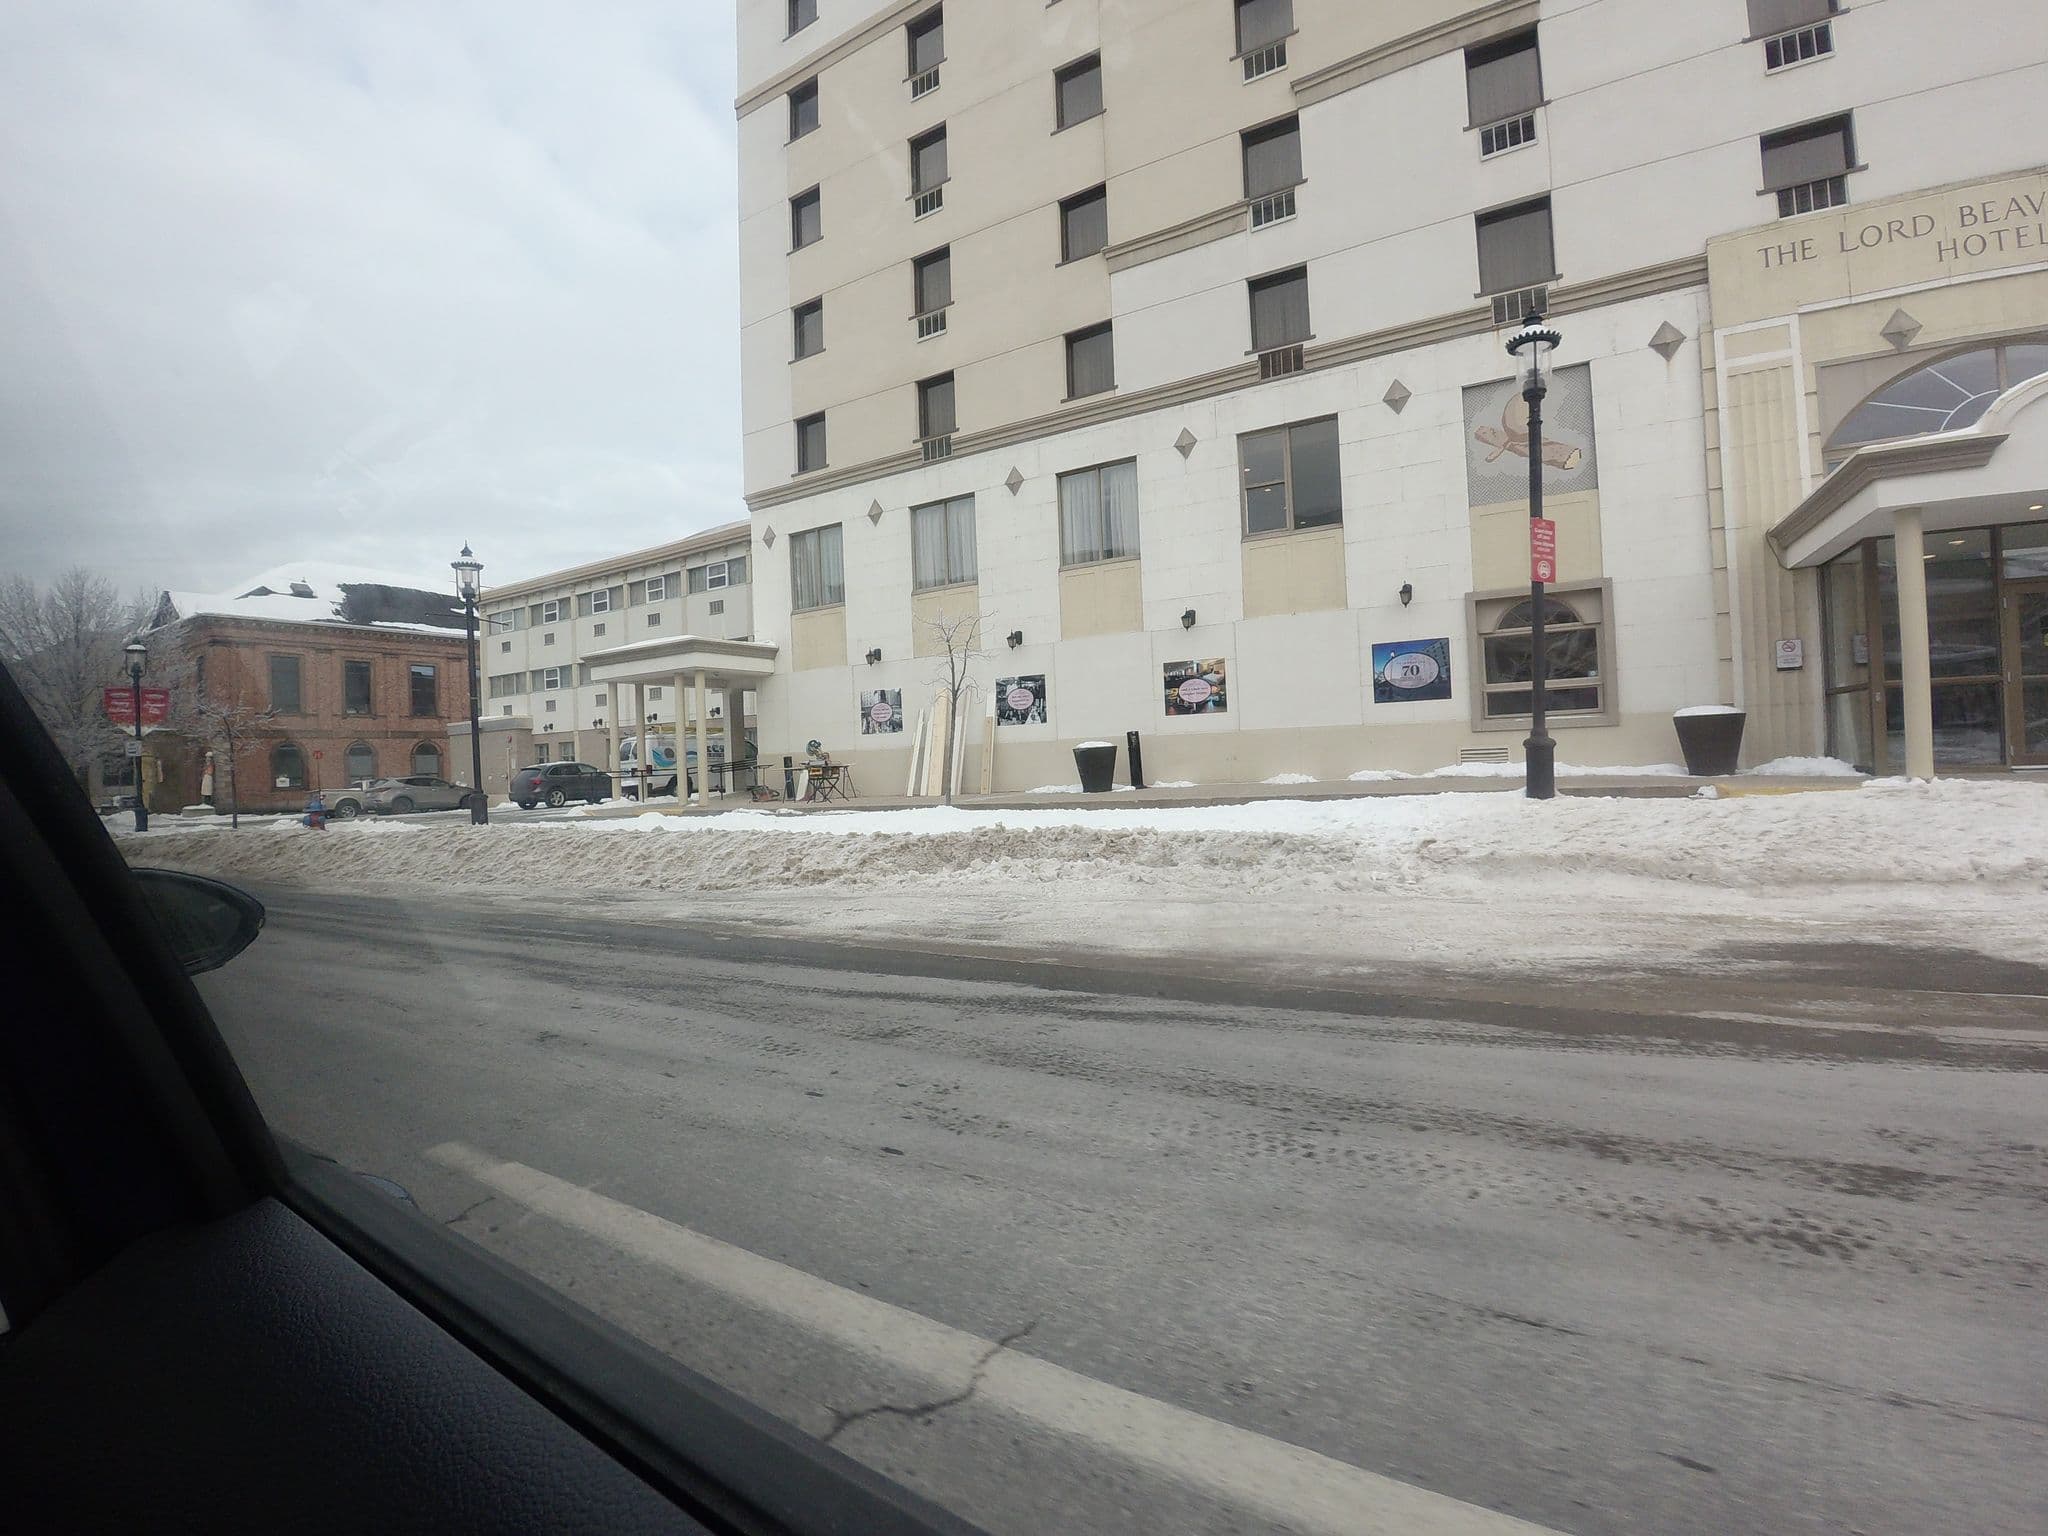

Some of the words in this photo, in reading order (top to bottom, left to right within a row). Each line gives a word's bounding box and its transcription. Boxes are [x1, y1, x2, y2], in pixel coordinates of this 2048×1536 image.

[1757, 238, 1818, 269] THE
[1839, 214, 1935, 254] LORD
[1937, 223, 2048, 263] HOTEL
[1401, 664, 1420, 677] 70
